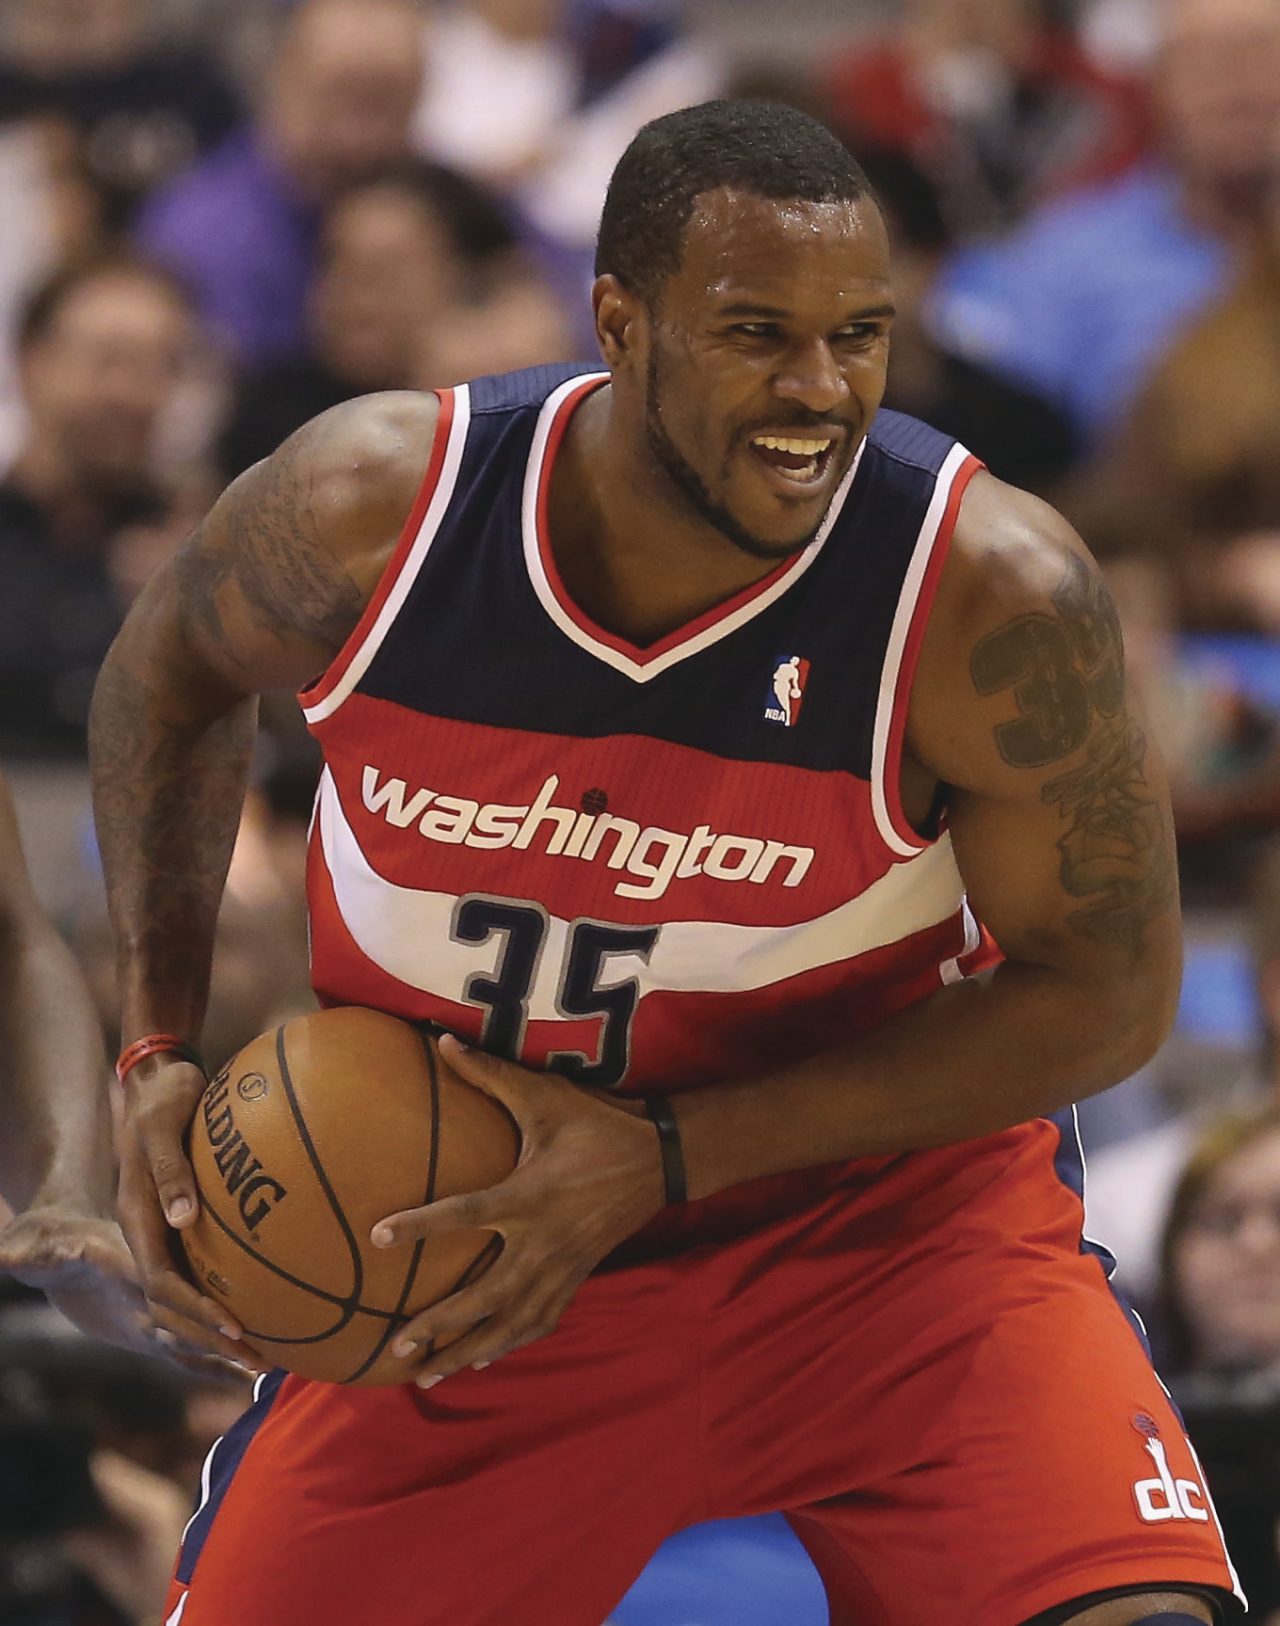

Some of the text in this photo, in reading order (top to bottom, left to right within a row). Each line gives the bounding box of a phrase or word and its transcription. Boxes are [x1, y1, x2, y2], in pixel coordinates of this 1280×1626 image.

[764, 706, 787, 723] NBA
[361, 764, 815, 900] washington
[449, 891, 662, 1086] 35
